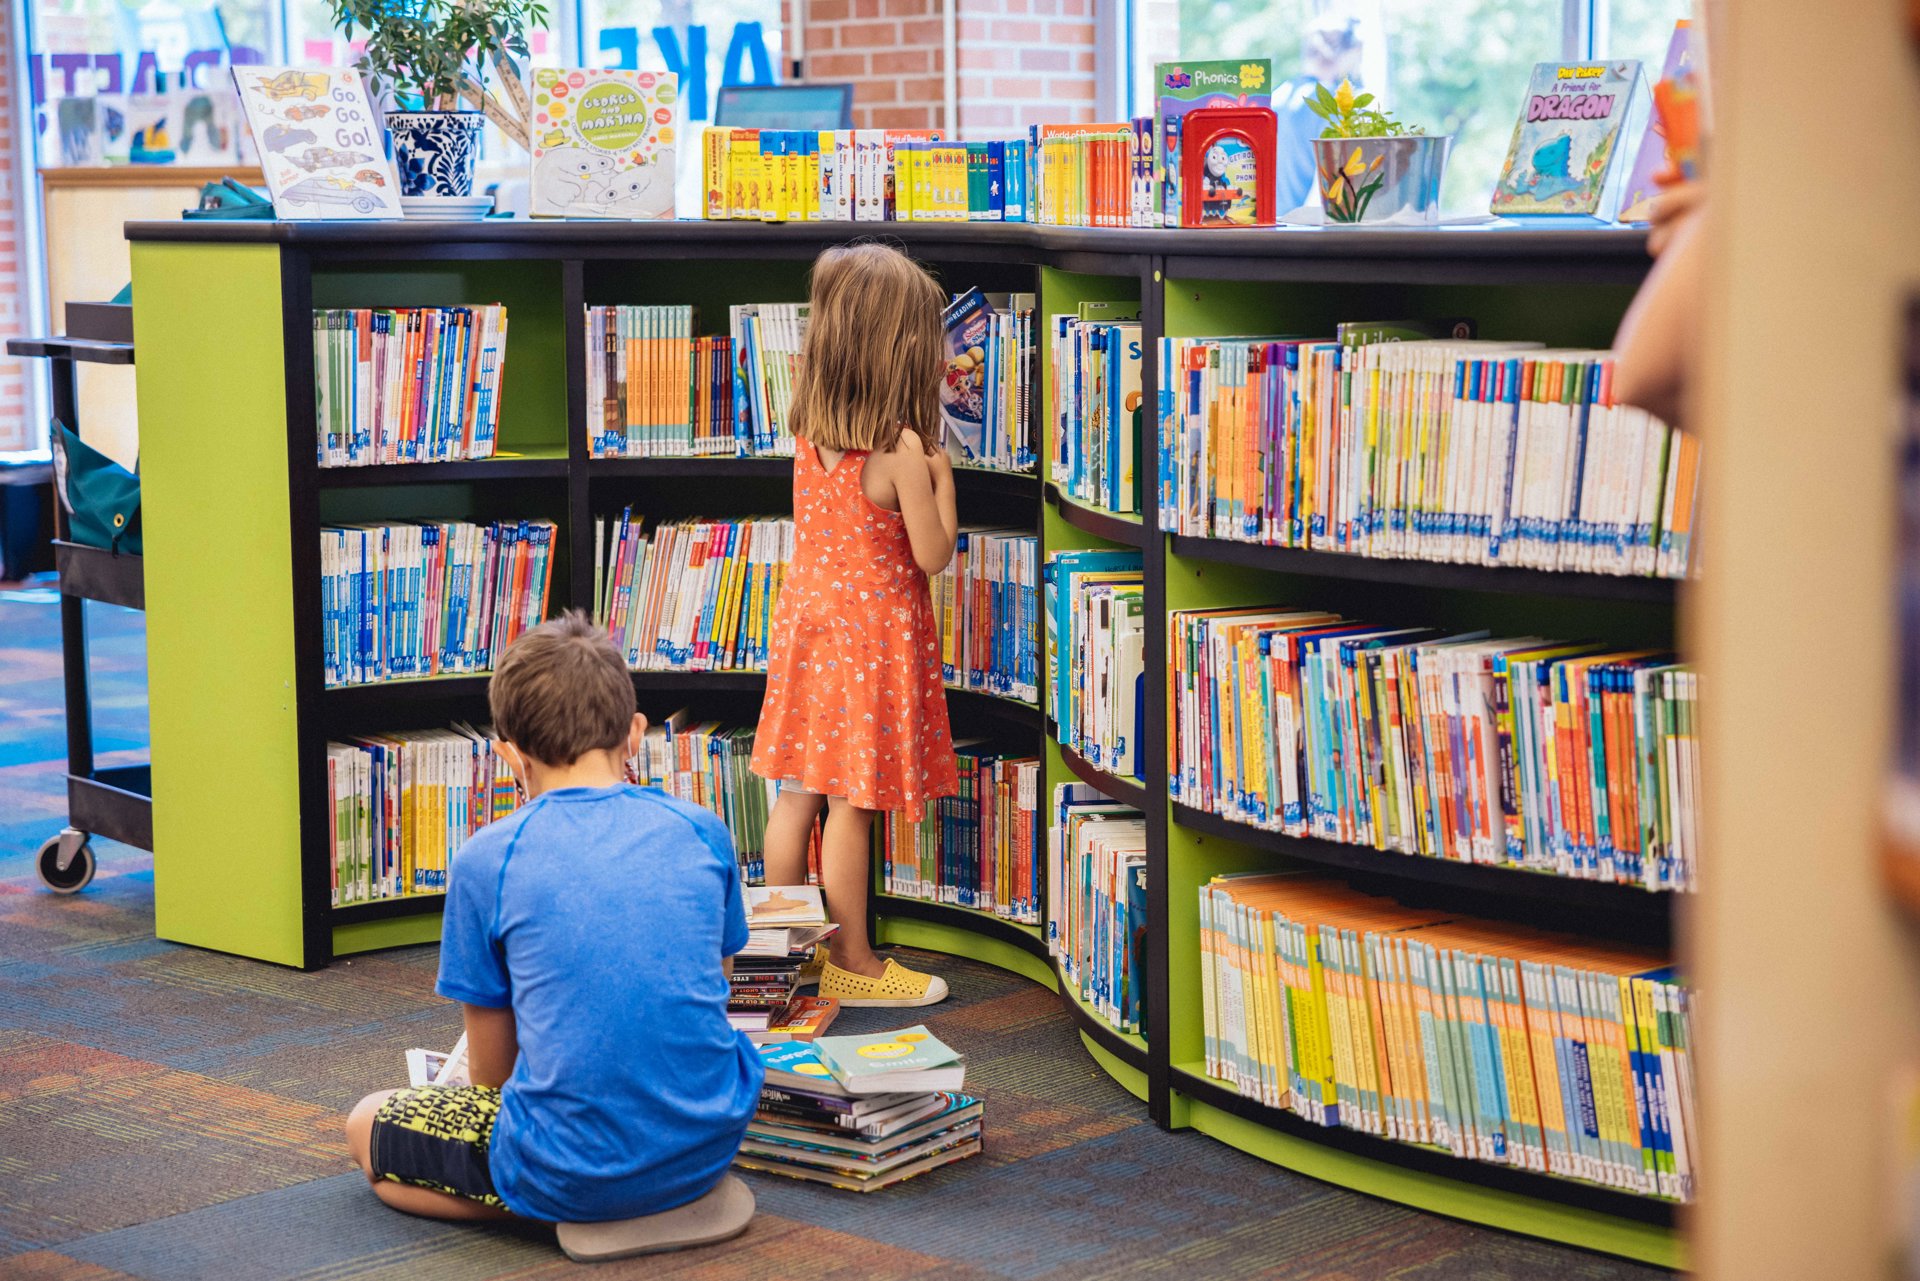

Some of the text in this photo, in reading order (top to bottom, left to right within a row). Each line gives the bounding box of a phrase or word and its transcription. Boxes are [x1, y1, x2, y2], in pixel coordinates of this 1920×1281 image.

[1195, 71, 1238, 87] Phonics
[1552, 82, 1602, 93] A Friend for
[584, 93, 637, 109] GEORGE
[1527, 94, 1615, 123] DRAGON
[601, 106, 621, 115] AND
[581, 112, 644, 130] MARTHA
[336, 126, 372, 148] Go!
[1047, 130, 1070, 138] World
[1230, 154, 1241, 163] GET
[952, 298, 977, 321] READING
